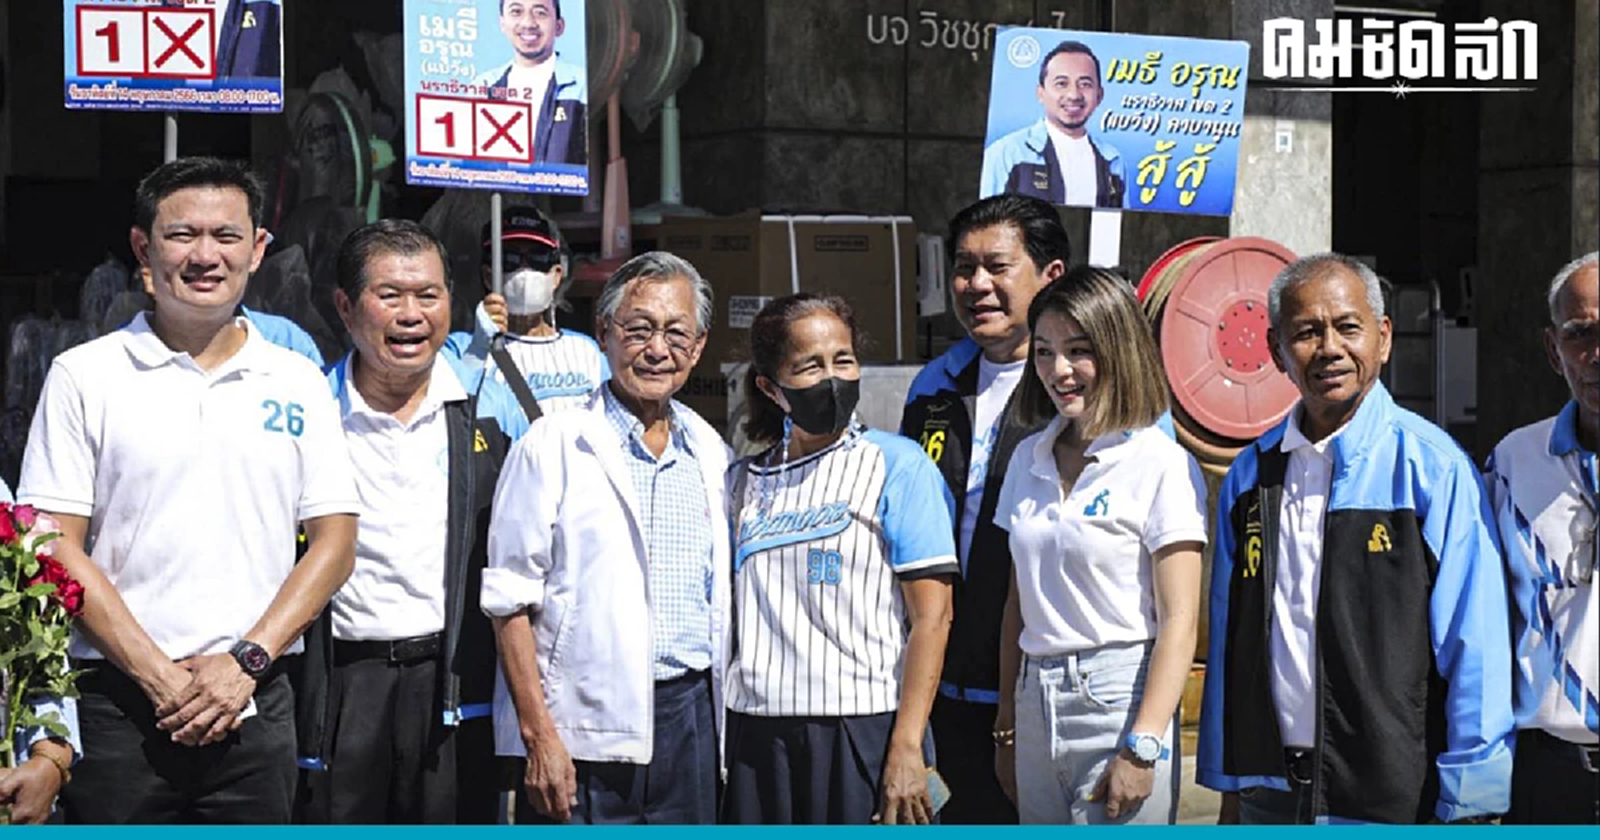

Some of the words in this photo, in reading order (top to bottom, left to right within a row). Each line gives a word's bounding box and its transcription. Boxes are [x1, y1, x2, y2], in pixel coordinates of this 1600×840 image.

[419, 7, 478, 40] เมธี
[867, 14, 909, 45] บจ
[95, 21, 120, 63] 1
[419, 38, 474, 63] อรุณ
[420, 78, 488, 96] นราธิวาส
[523, 87, 533, 100] 2
[1106, 51, 1164, 84] เมธี
[1170, 60, 1243, 98] อรุณ
[1121, 92, 1187, 113] นราธิวาส
[1220, 98, 1234, 116] 2
[435, 112, 455, 148] 1
[1136, 138, 1177, 206] สู้
[1176, 142, 1218, 208] สู้
[261, 399, 305, 437] 26
[807, 548, 842, 585] 98
